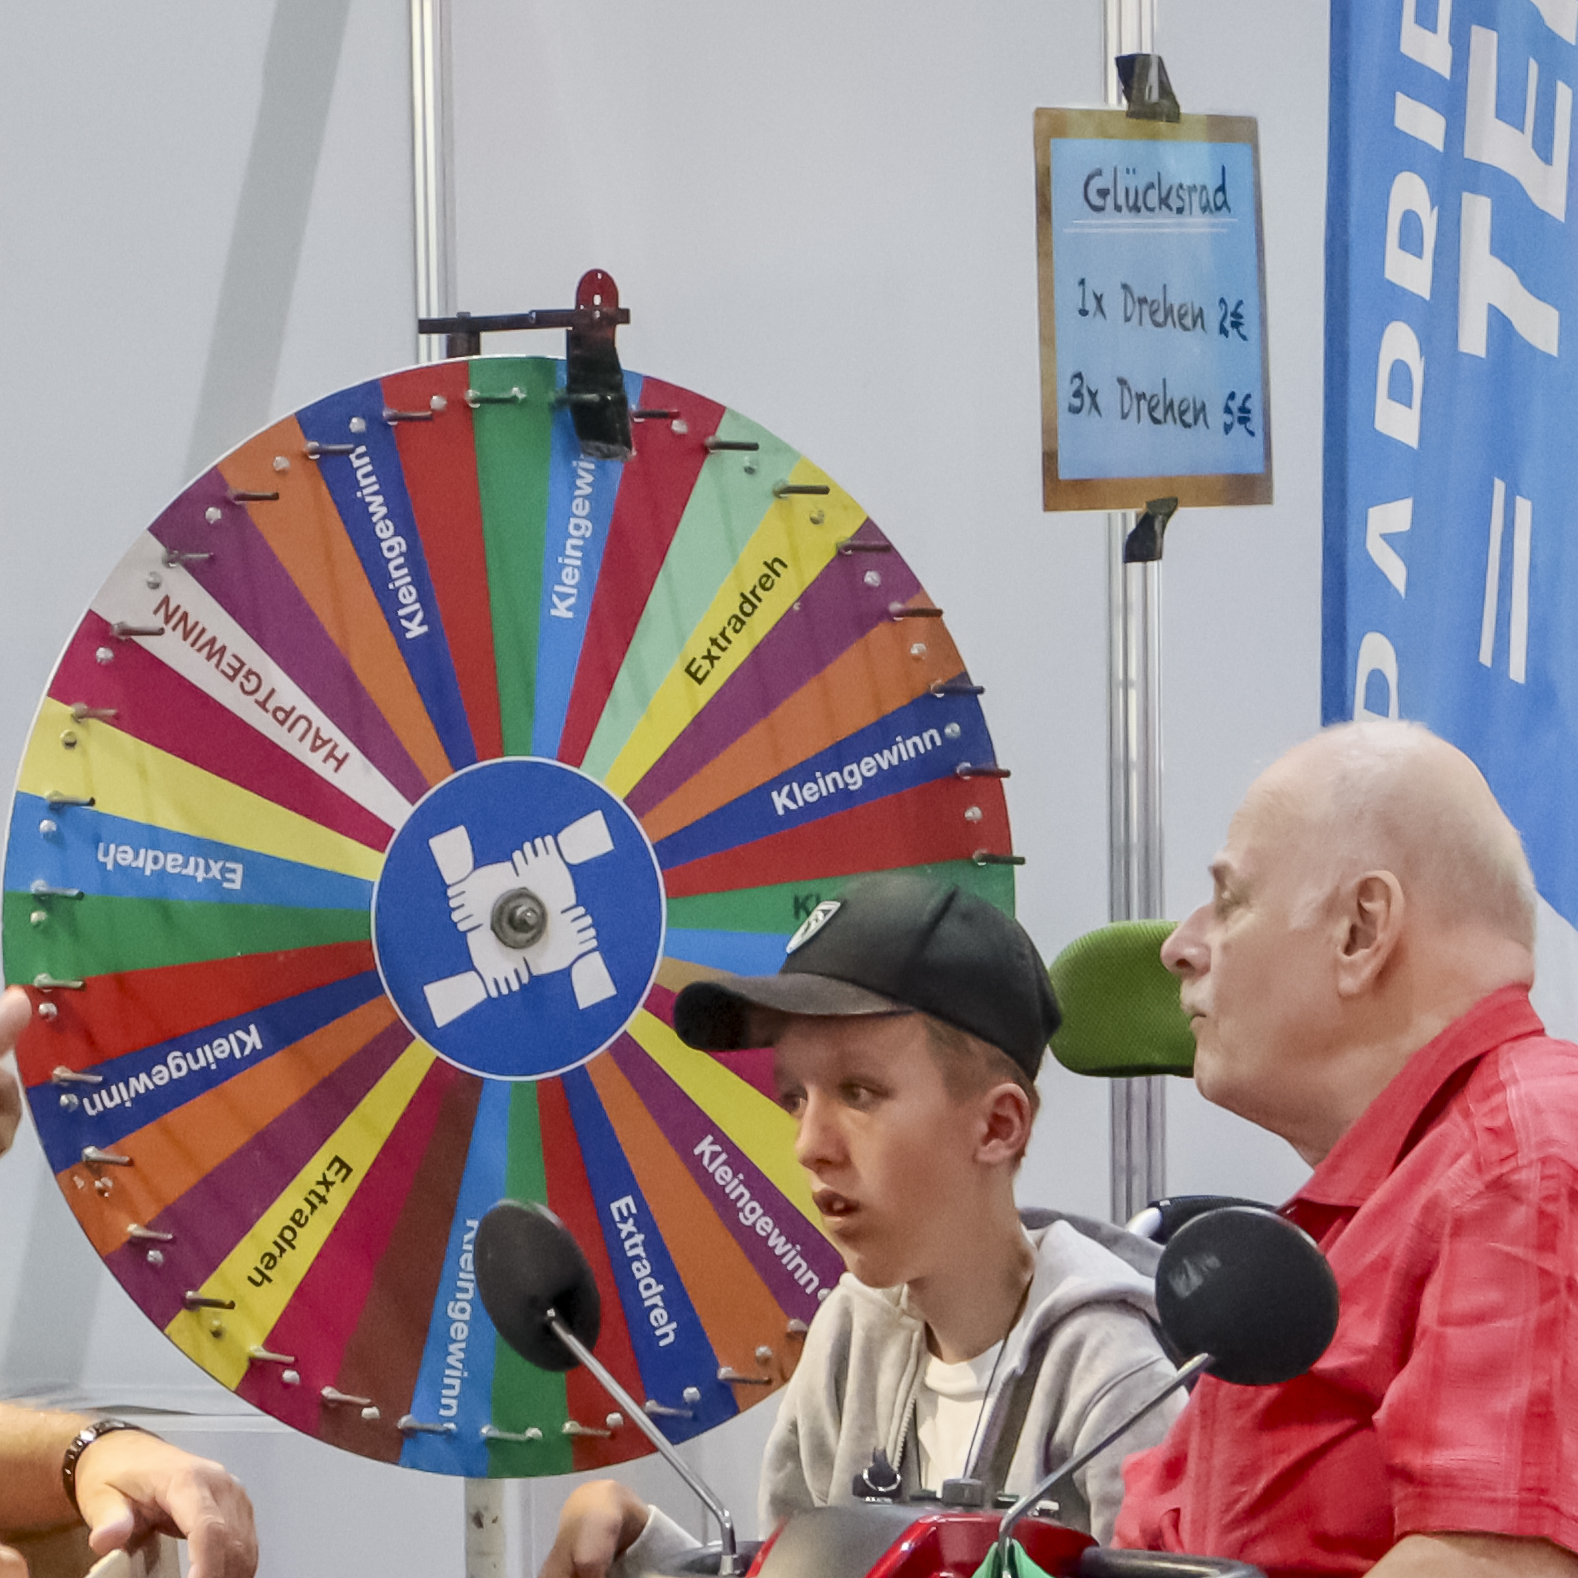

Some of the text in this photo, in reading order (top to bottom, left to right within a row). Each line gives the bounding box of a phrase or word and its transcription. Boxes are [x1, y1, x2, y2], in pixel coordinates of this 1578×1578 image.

[1082, 165, 1232, 215] Glücksrad
[1076, 277, 1249, 342] 1x Drehen 2€
[1067, 371, 1256, 437] 3x Drehen 5€
[349, 444, 429, 641] Kleingewinn
[683, 553, 789, 688] Extradreh
[152, 593, 351, 774] HAUPTGEWINN
[769, 724, 944, 818] Kleingewinn
[97, 840, 245, 891] Extradreh
[81, 1023, 264, 1117] Kleingewinn
[245, 1155, 354, 1290] Extradreh
[609, 1193, 679, 1349] Extradreh
[692, 1134, 822, 1300] Kleingewinn
